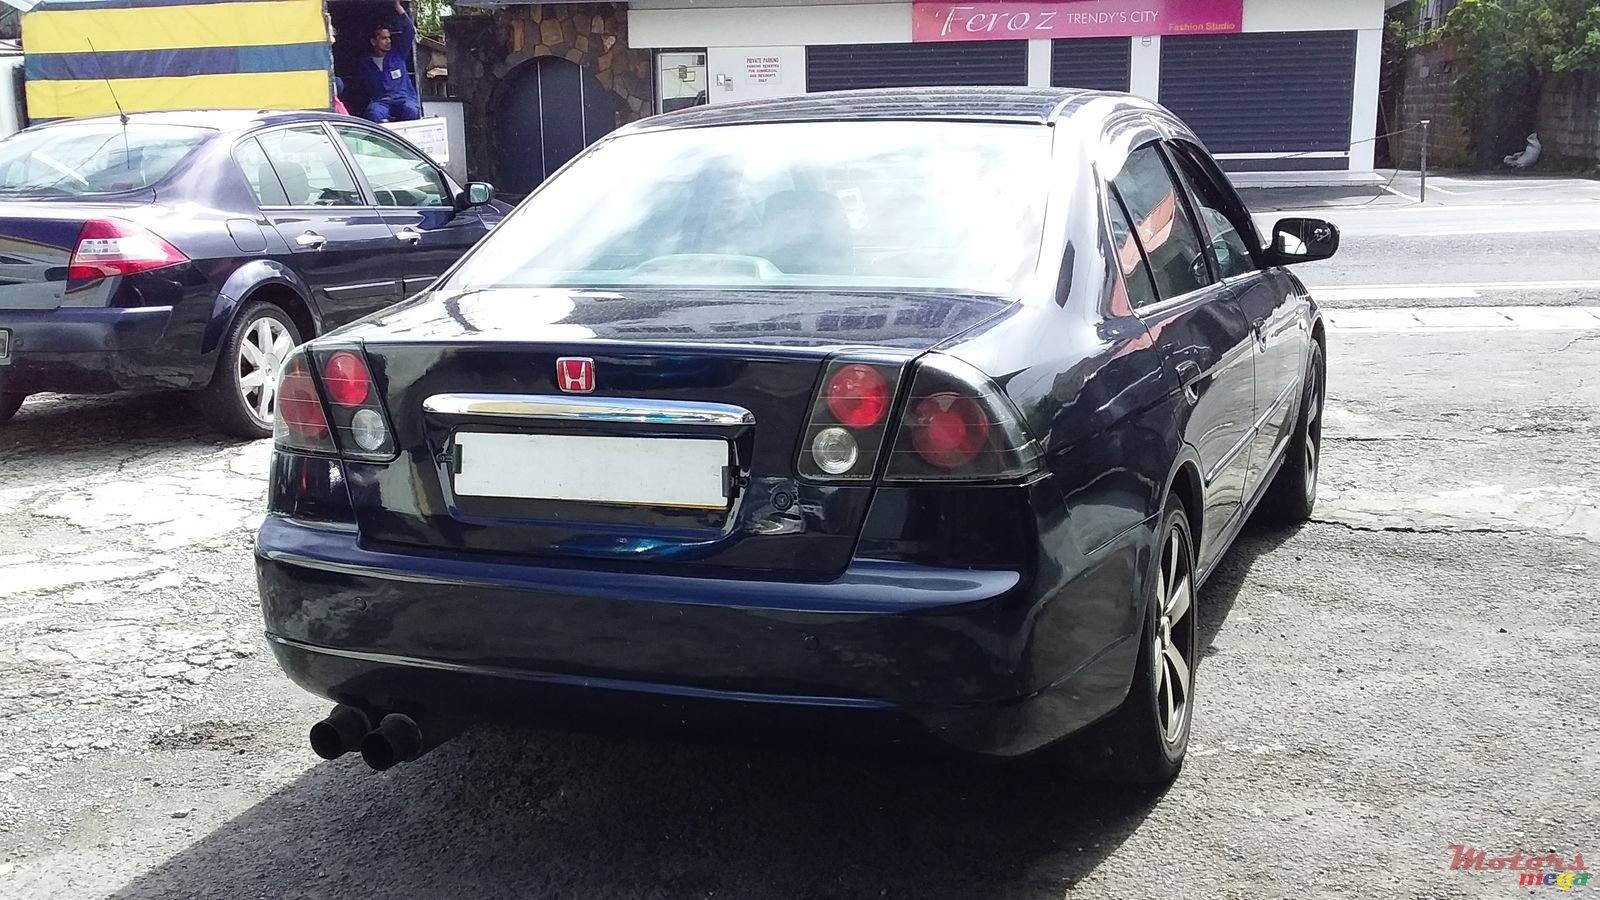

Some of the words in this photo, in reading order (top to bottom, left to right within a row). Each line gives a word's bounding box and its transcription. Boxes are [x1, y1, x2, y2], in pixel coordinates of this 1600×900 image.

[935, 6, 1057, 36] Feroz
[1067, 11, 1127, 24] TRENDY'S
[1130, 10, 1159, 23] CITY
[1168, 23, 1204, 31] Fashion
[1206, 22, 1235, 30] Studio
